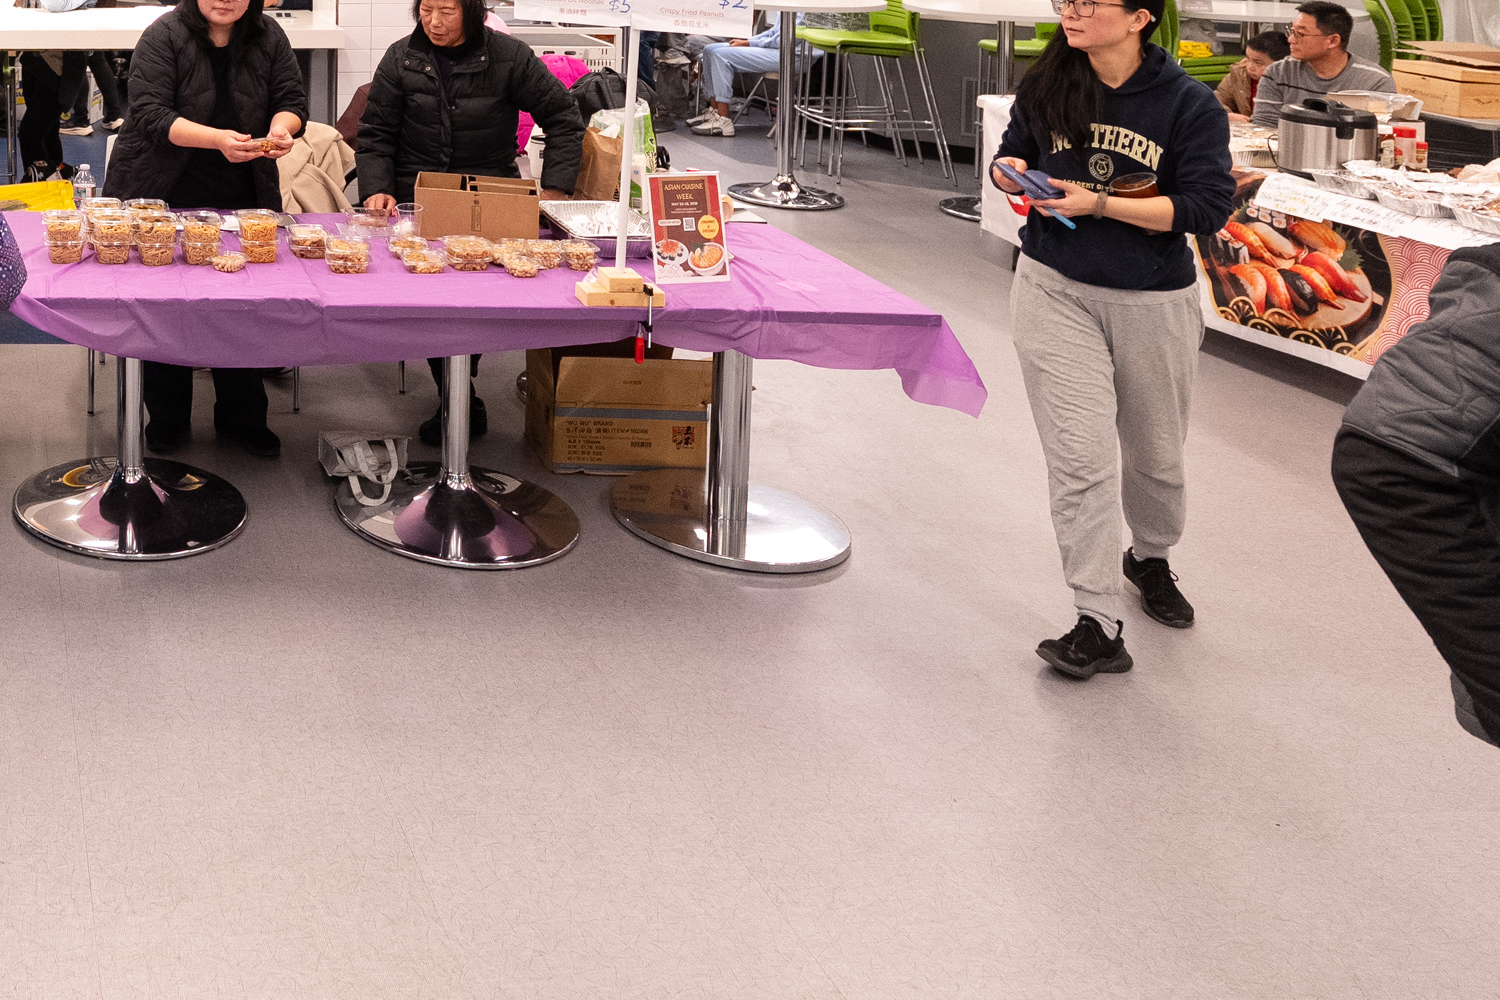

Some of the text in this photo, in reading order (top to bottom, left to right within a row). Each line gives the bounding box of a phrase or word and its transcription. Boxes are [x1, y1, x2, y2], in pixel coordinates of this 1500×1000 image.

[660, 6, 725, 18] Crispy Fried Peanuts
[1049, 122, 1164, 172] NTHERN
